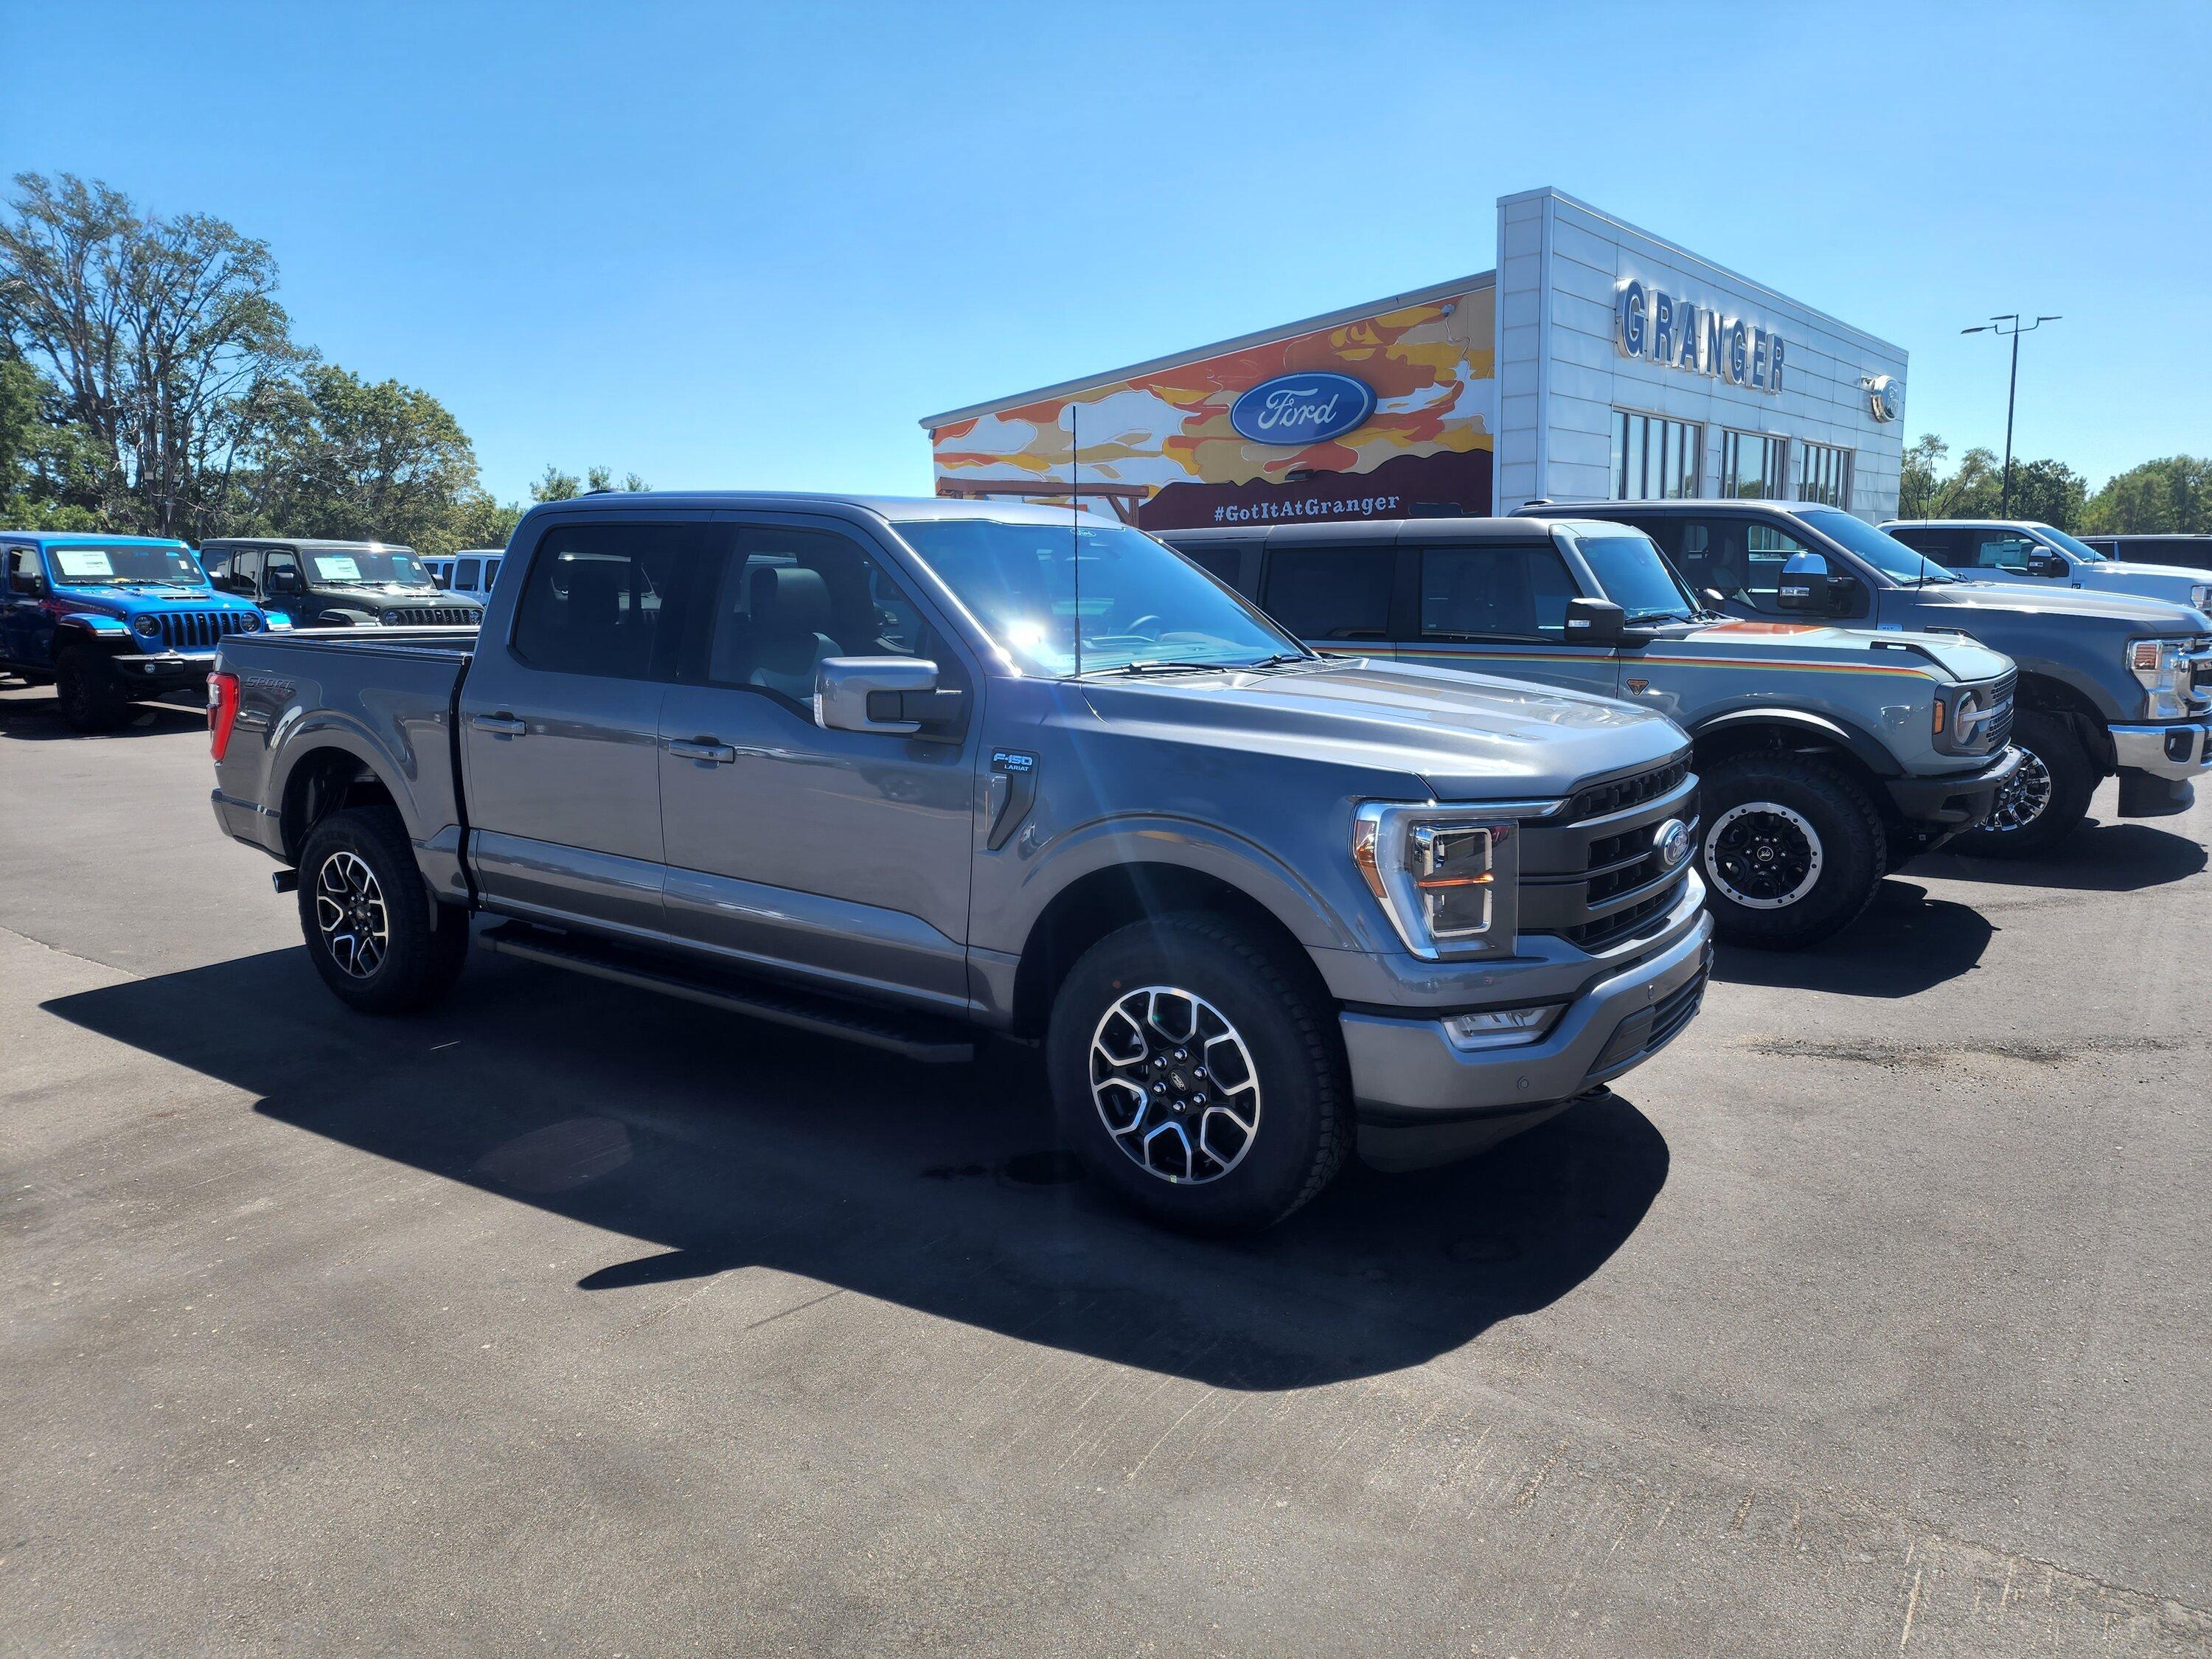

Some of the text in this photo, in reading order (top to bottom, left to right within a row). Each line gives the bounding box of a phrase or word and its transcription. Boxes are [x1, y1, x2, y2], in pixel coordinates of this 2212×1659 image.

[1618, 278, 1785, 394] GRANGER
[1257, 388, 1339, 429] Ford
[1214, 495, 1401, 521] #GotItAtGranger
[245, 677, 295, 689] SPORT
[993, 753, 1033, 766] F-150
[1004, 764, 1029, 772] LARIAT
